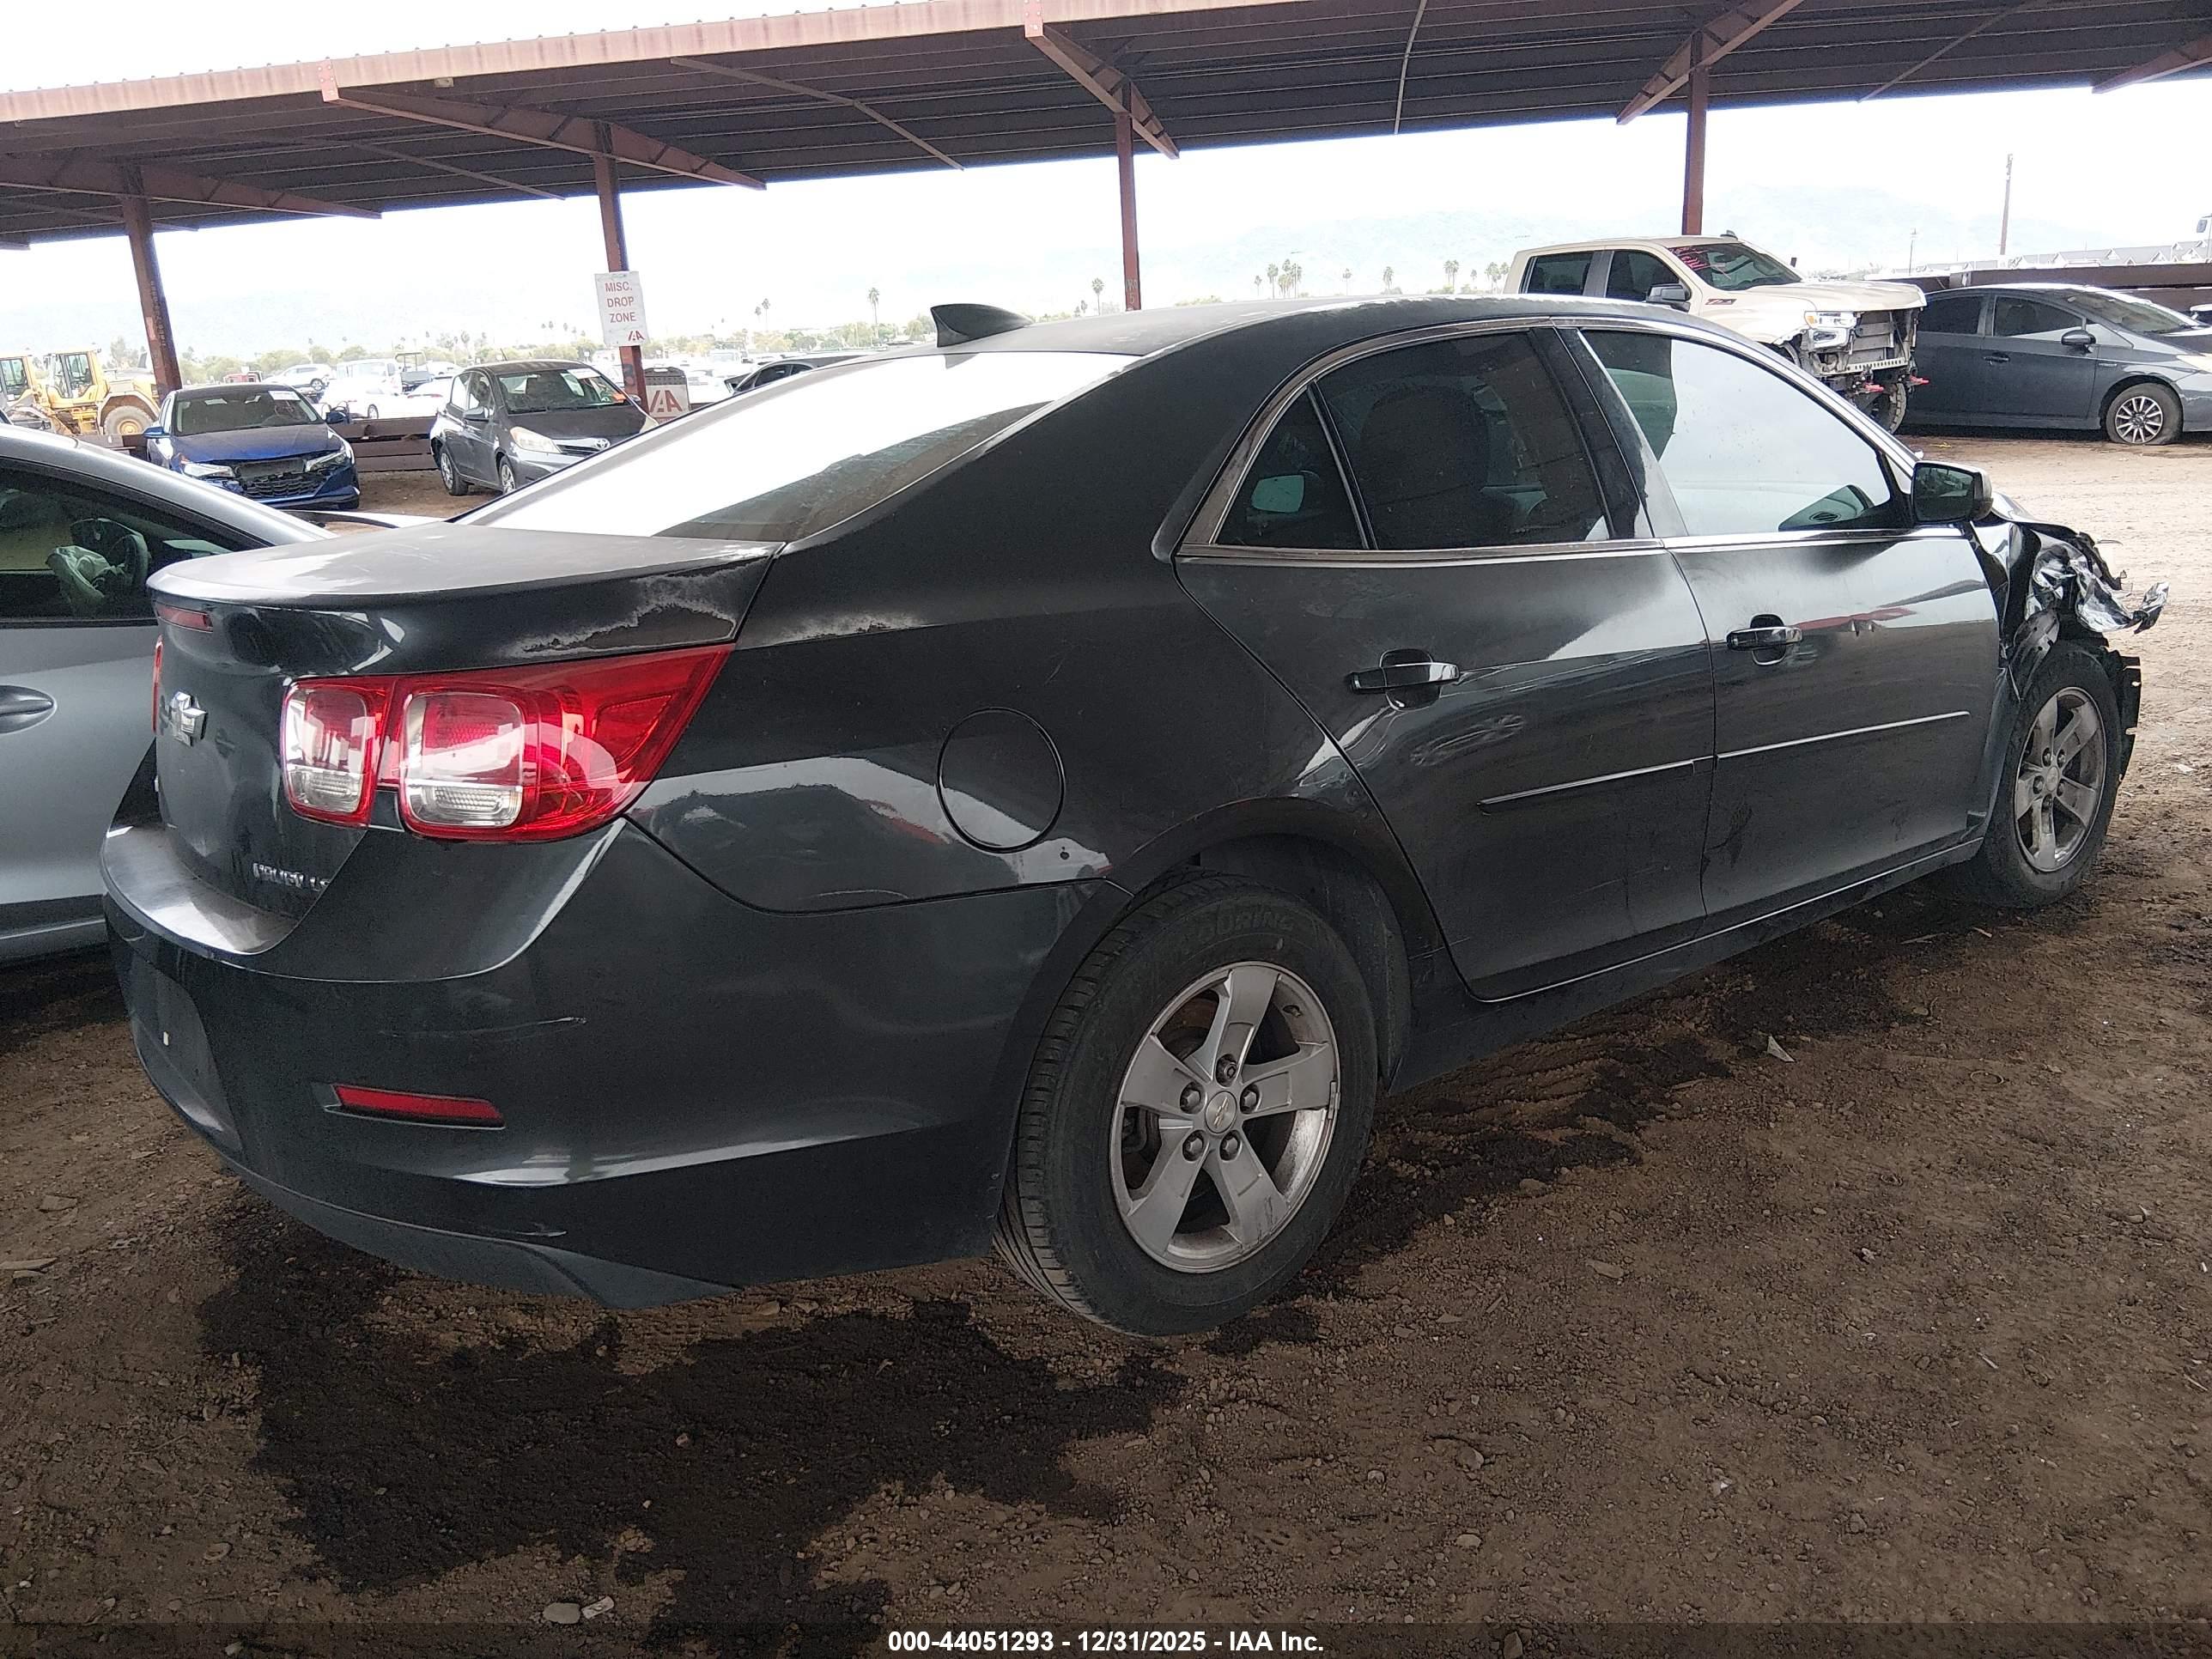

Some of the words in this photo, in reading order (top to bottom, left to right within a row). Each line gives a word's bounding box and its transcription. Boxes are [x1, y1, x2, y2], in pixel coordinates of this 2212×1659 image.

[605, 281, 633, 293] MISC.
[606, 296, 635, 308] DROP
[609, 312, 636, 324] ZONE
